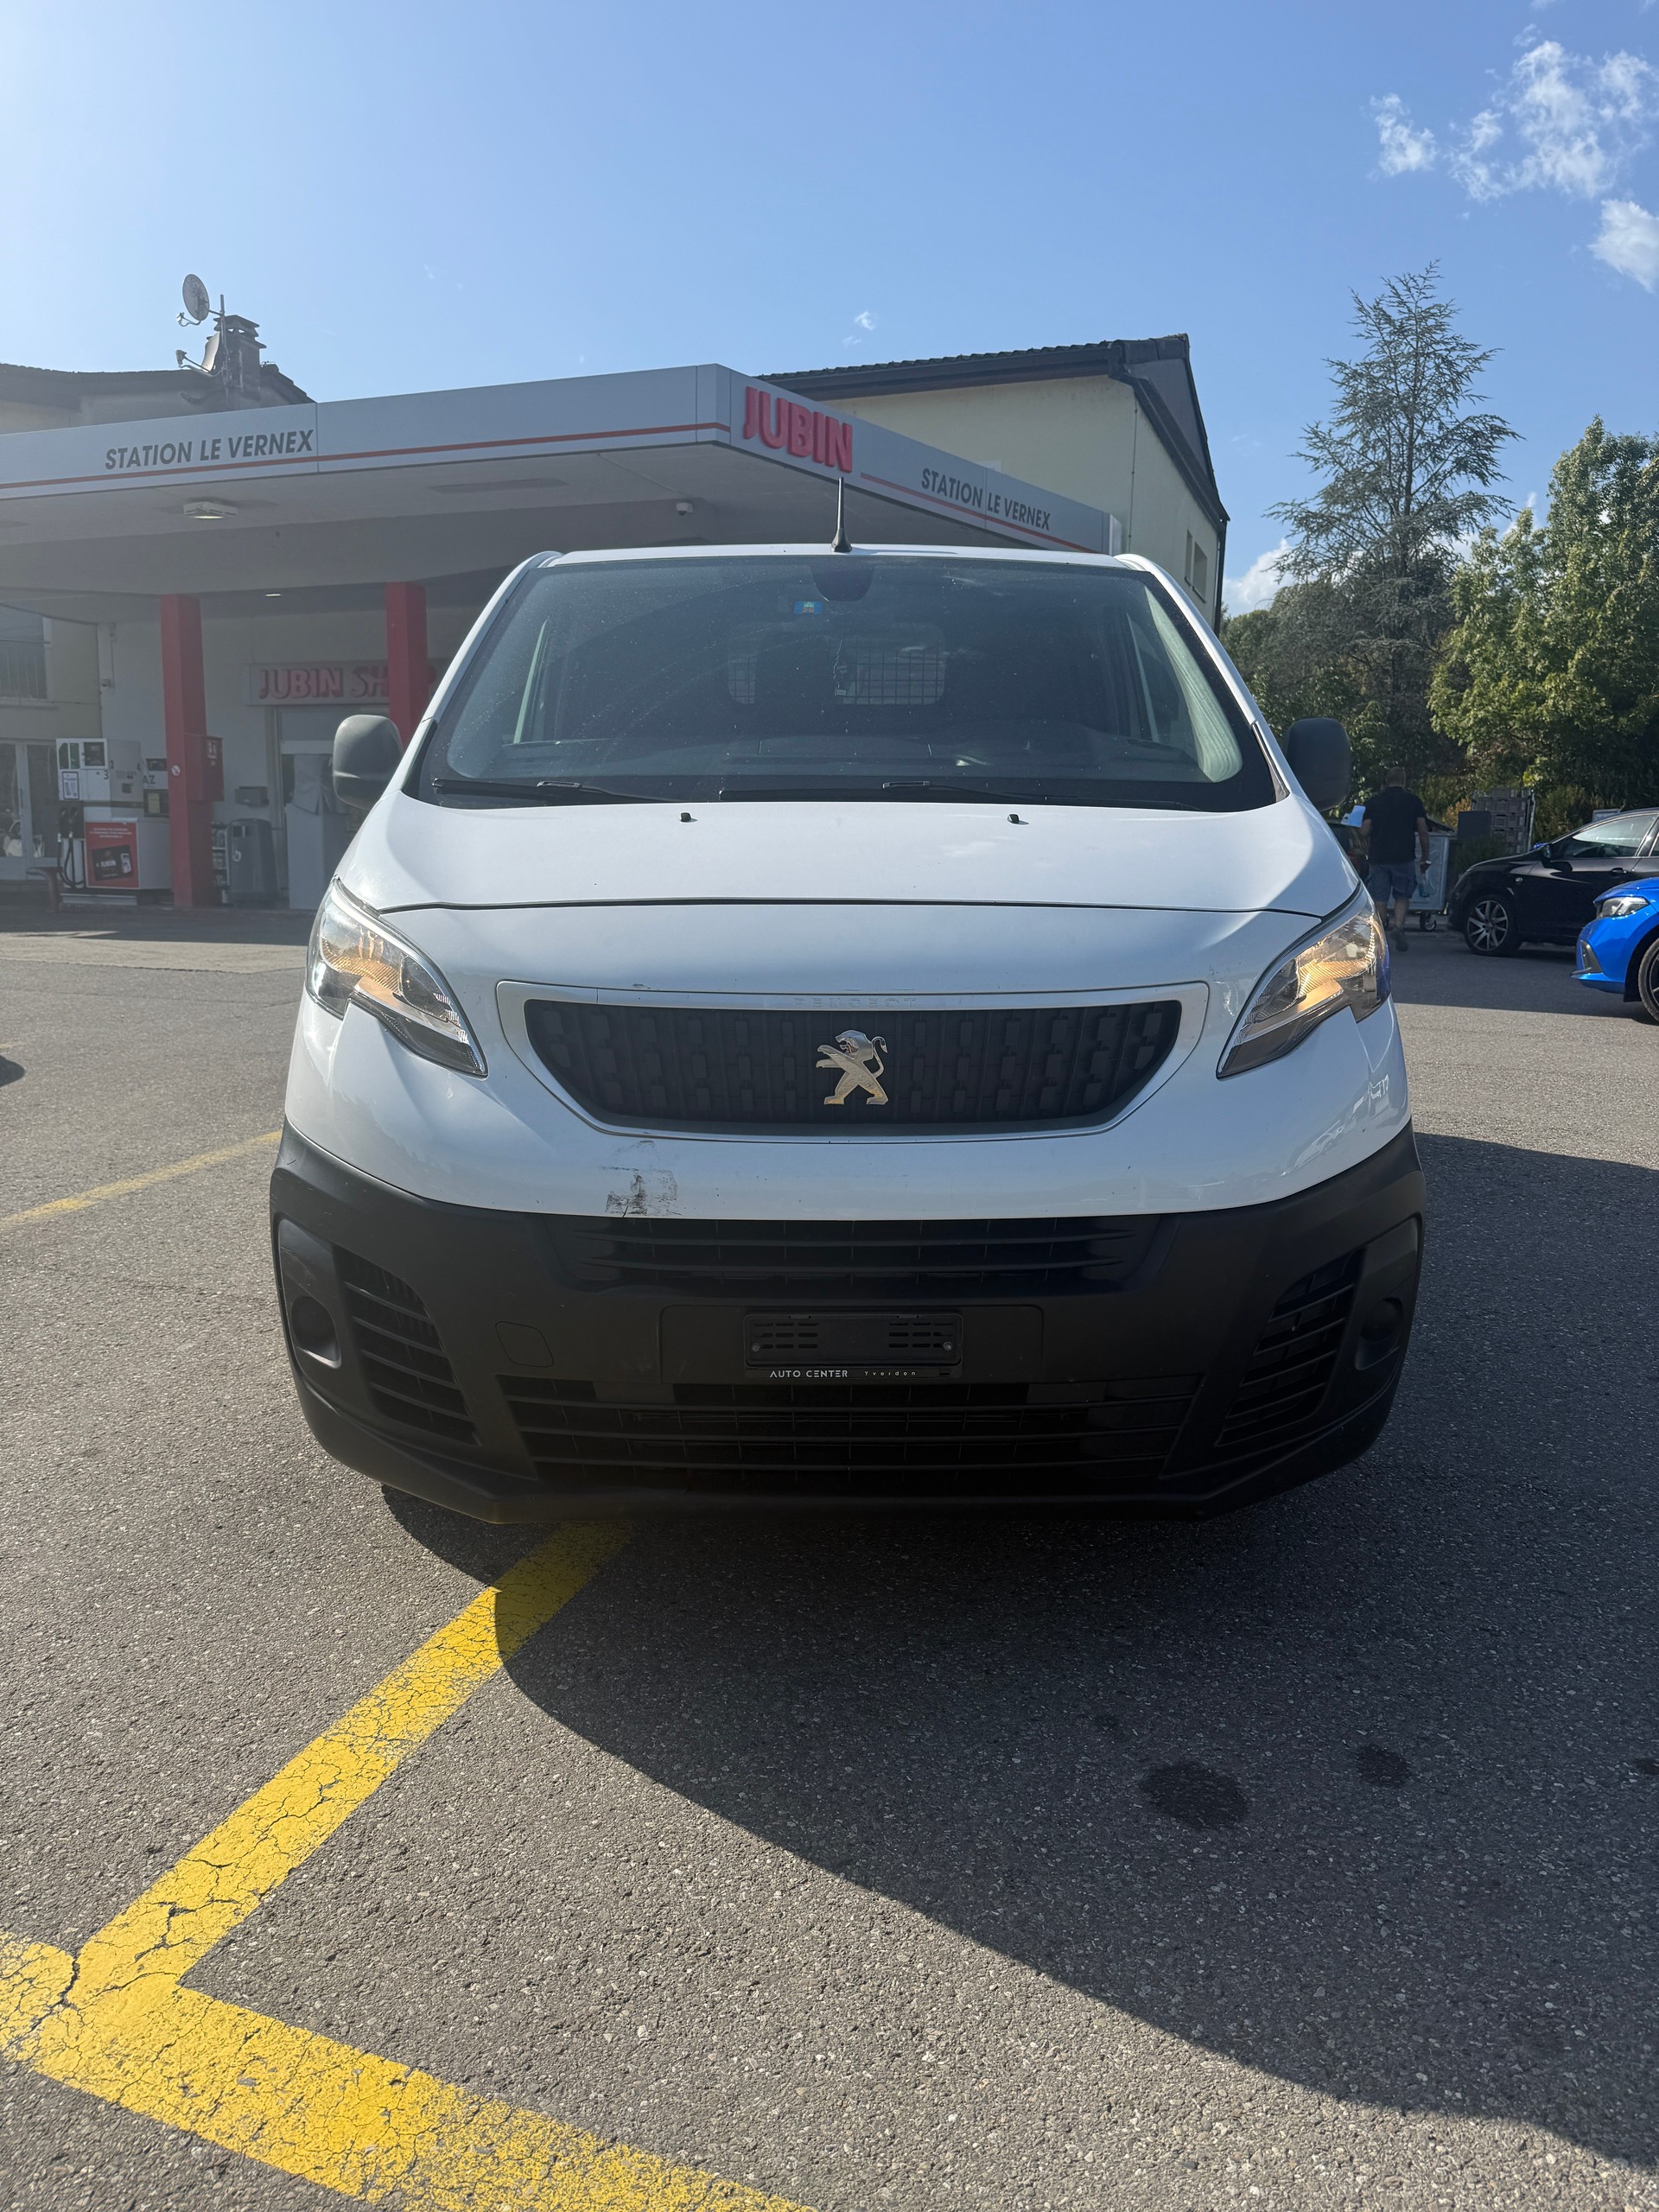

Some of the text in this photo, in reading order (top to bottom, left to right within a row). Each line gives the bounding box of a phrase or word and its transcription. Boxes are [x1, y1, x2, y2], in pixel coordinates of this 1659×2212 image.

[742, 385, 853, 474] JUBIN
[105, 429, 314, 470] STATION LE VERNEX
[921, 467, 1051, 531] STATION LE VERNEX
[259, 668, 343, 699] JUBIN
[794, 996, 917, 1009] PEUGEOT
[769, 1370, 801, 1378] AUTO
[805, 1370, 848, 1378] CENTER
